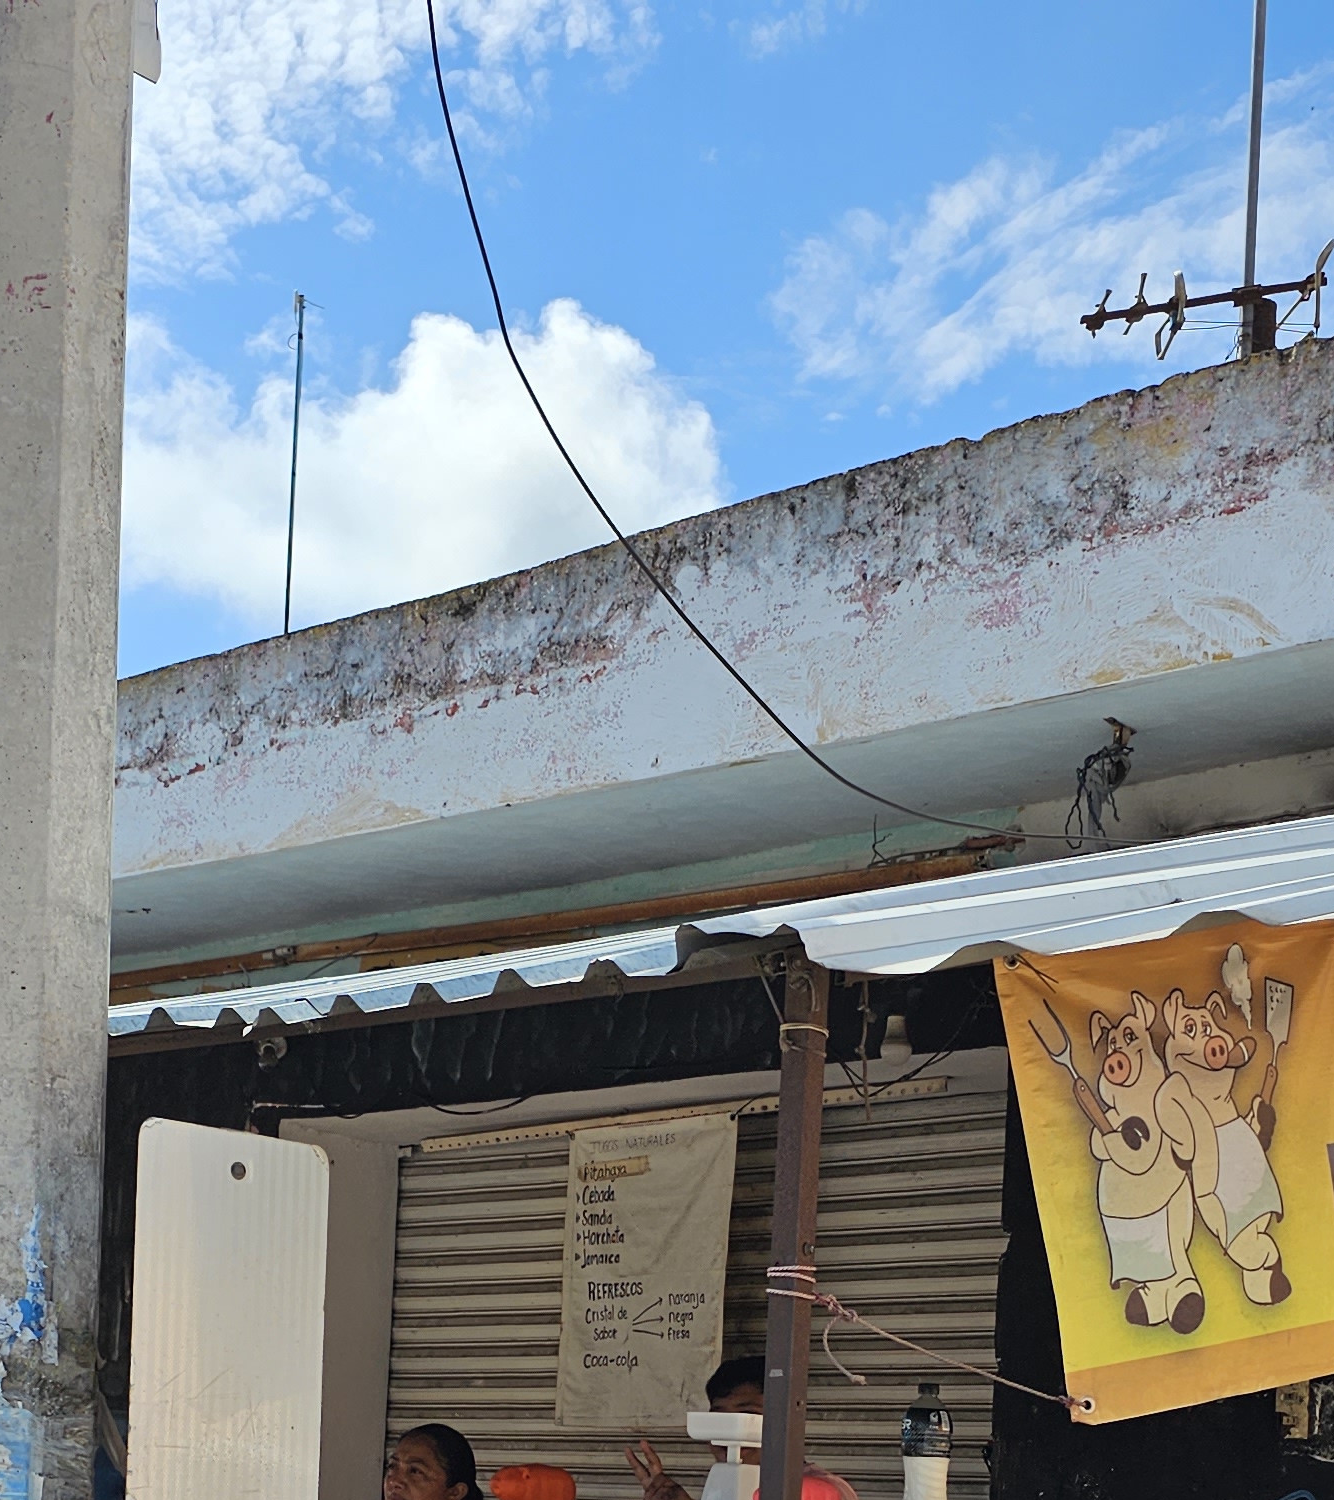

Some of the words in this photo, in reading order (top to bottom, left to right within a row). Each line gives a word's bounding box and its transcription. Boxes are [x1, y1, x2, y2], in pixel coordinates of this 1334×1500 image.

[589, 1139, 618, 1154] JUGOS
[624, 1133, 676, 1149] NATURALES
[582, 1186, 615, 1204] Cebada
[582, 1226, 625, 1246] Horchata
[581, 1246, 620, 1269] Jamaica
[588, 1280, 644, 1301] REFRESCOS
[585, 1307, 614, 1324] Cristal
[617, 1307, 628, 1321] de
[668, 1293, 706, 1310] naranja
[668, 1310, 694, 1324] negra
[667, 1328, 691, 1341] fresa
[583, 1350, 639, 1373] Coca-cola
